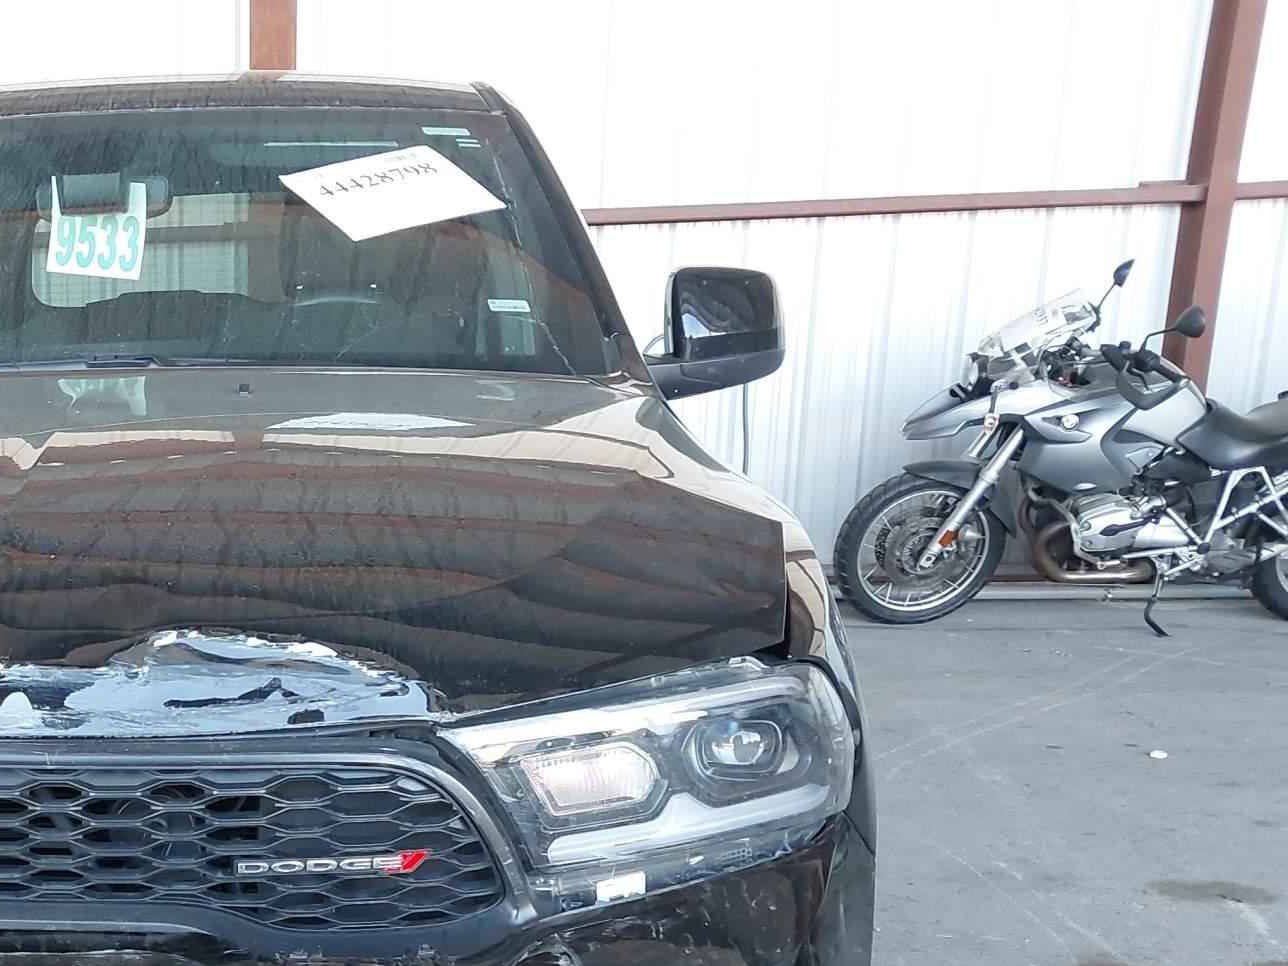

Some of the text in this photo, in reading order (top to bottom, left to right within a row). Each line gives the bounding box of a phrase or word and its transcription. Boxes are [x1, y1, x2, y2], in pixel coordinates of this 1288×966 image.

[319, 162, 438, 197] 44428798
[55, 214, 140, 272] 9533
[237, 855, 404, 874] DODGE
